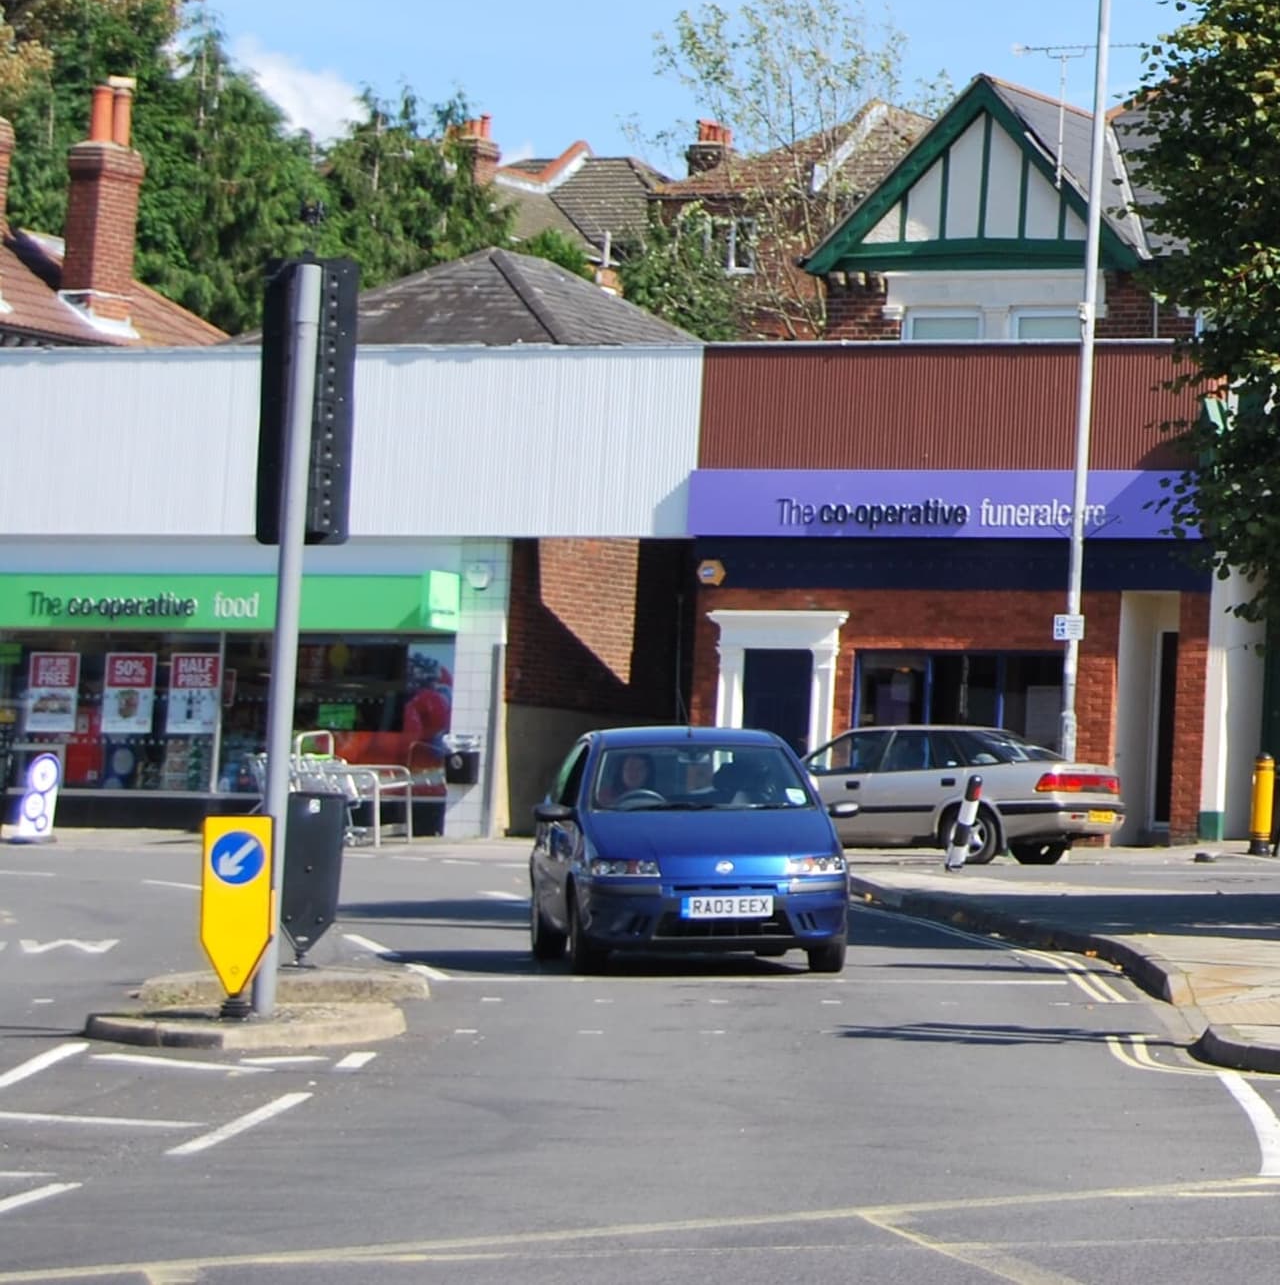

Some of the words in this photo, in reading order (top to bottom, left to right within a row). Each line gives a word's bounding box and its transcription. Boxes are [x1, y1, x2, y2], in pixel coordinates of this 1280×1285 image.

[776, 498, 816, 526] The
[820, 498, 970, 530] co-operative
[980, 498, 1107, 527] funeralcre
[28, 591, 62, 616] The
[67, 592, 198, 620] co-operative
[214, 591, 260, 618] food
[115, 659, 148, 676] 50%
[179, 657, 215, 673] HALF
[177, 673, 213, 687] PRICE
[692, 899, 734, 914] RA03
[738, 898, 769, 914] EEX
